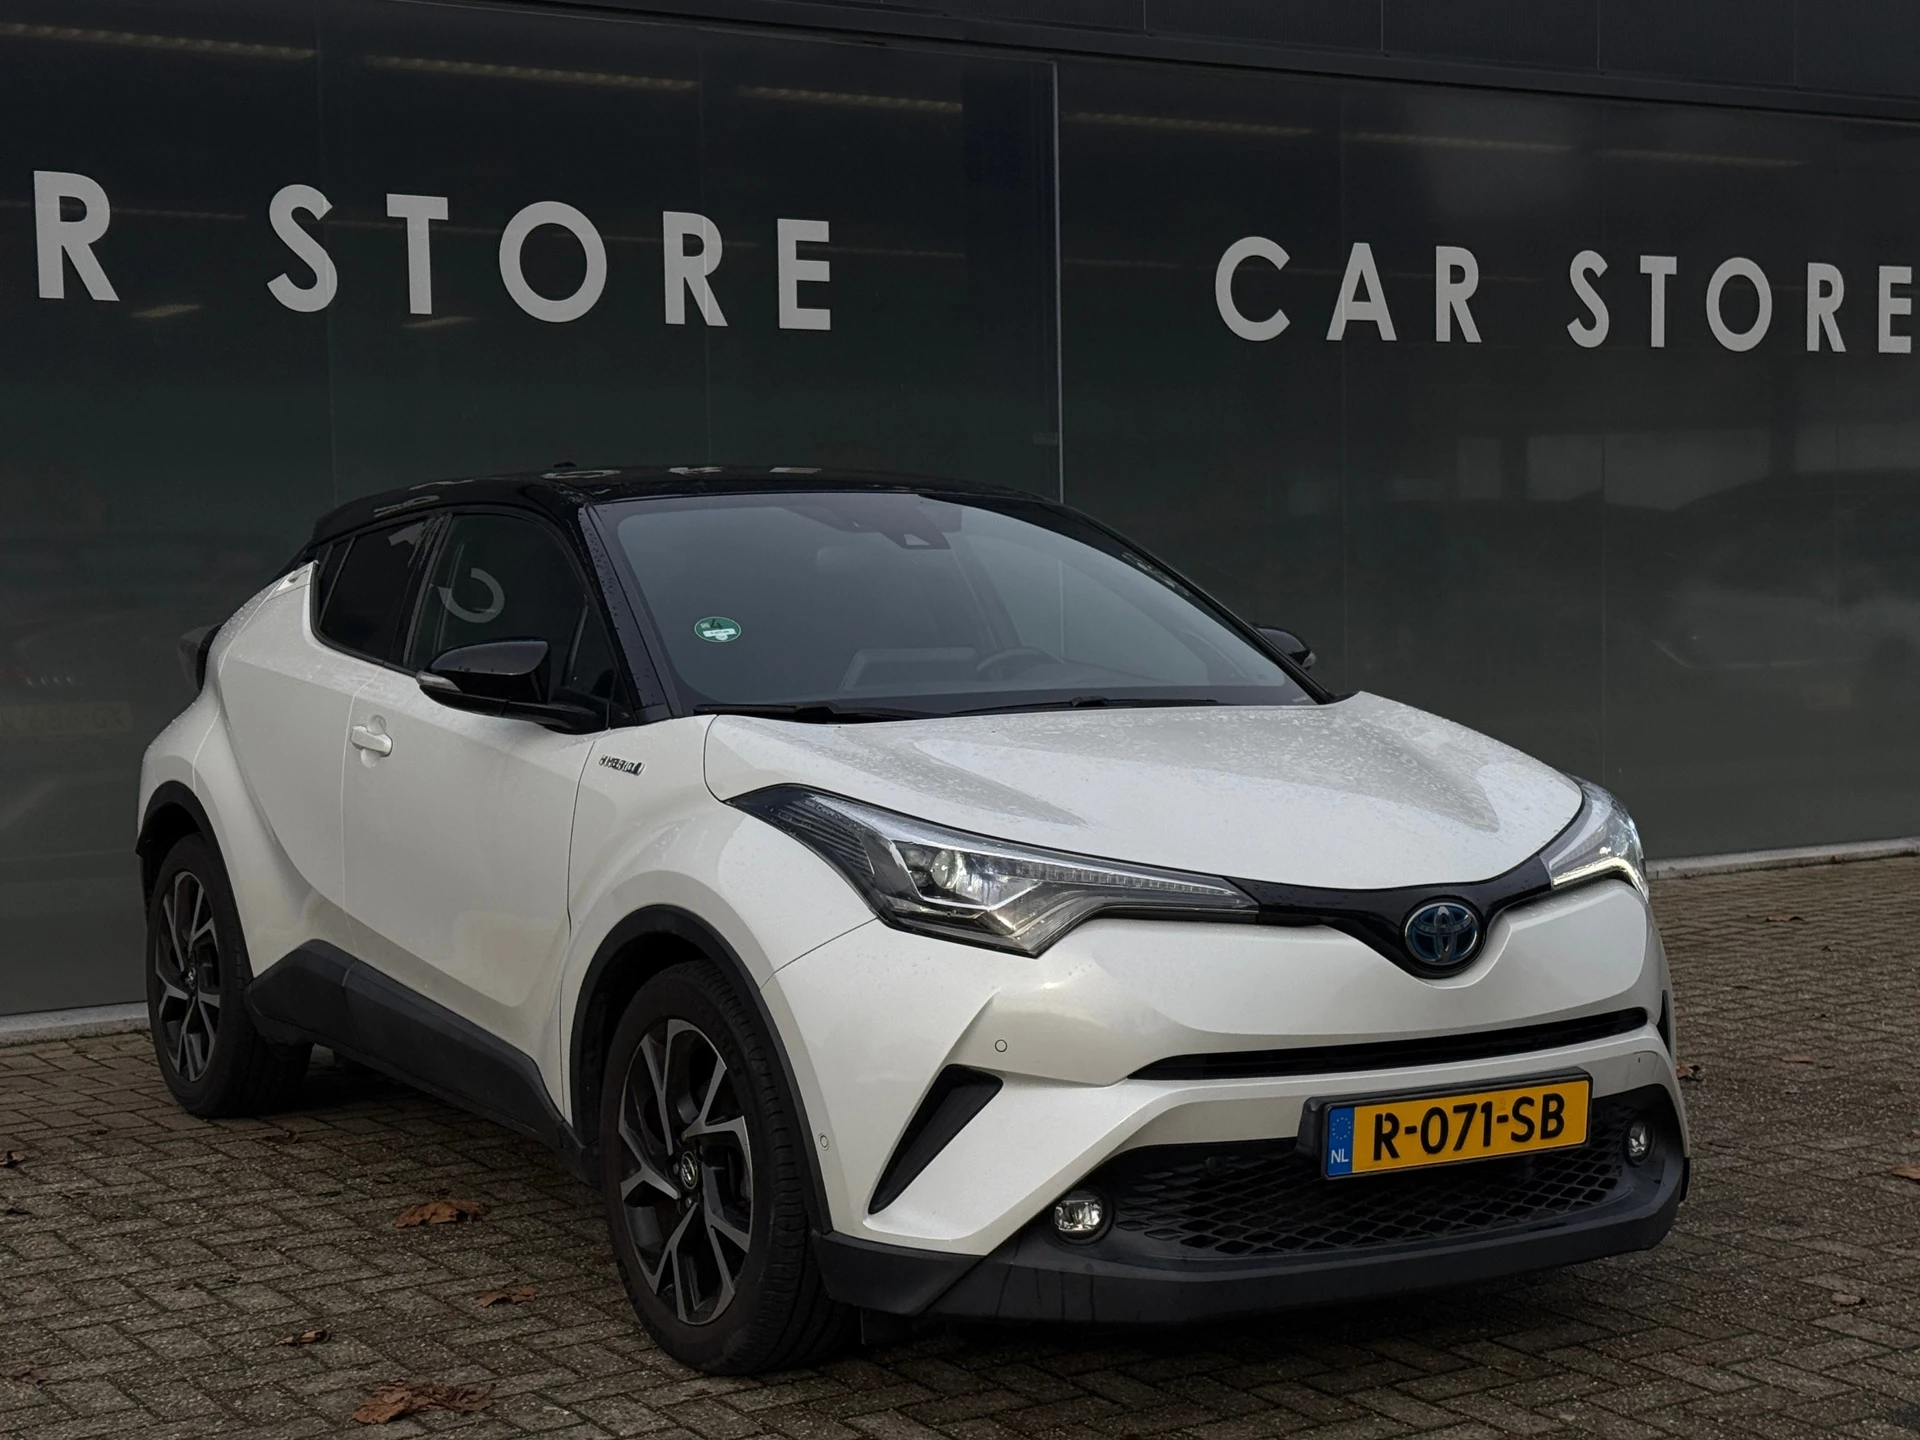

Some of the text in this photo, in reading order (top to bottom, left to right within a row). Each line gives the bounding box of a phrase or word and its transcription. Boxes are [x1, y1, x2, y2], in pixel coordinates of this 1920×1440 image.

[33, 170, 832, 331] R STORE
[1215, 236, 1913, 354] CAR STORE
[1330, 1093, 1565, 1164] NL R-071-SB
